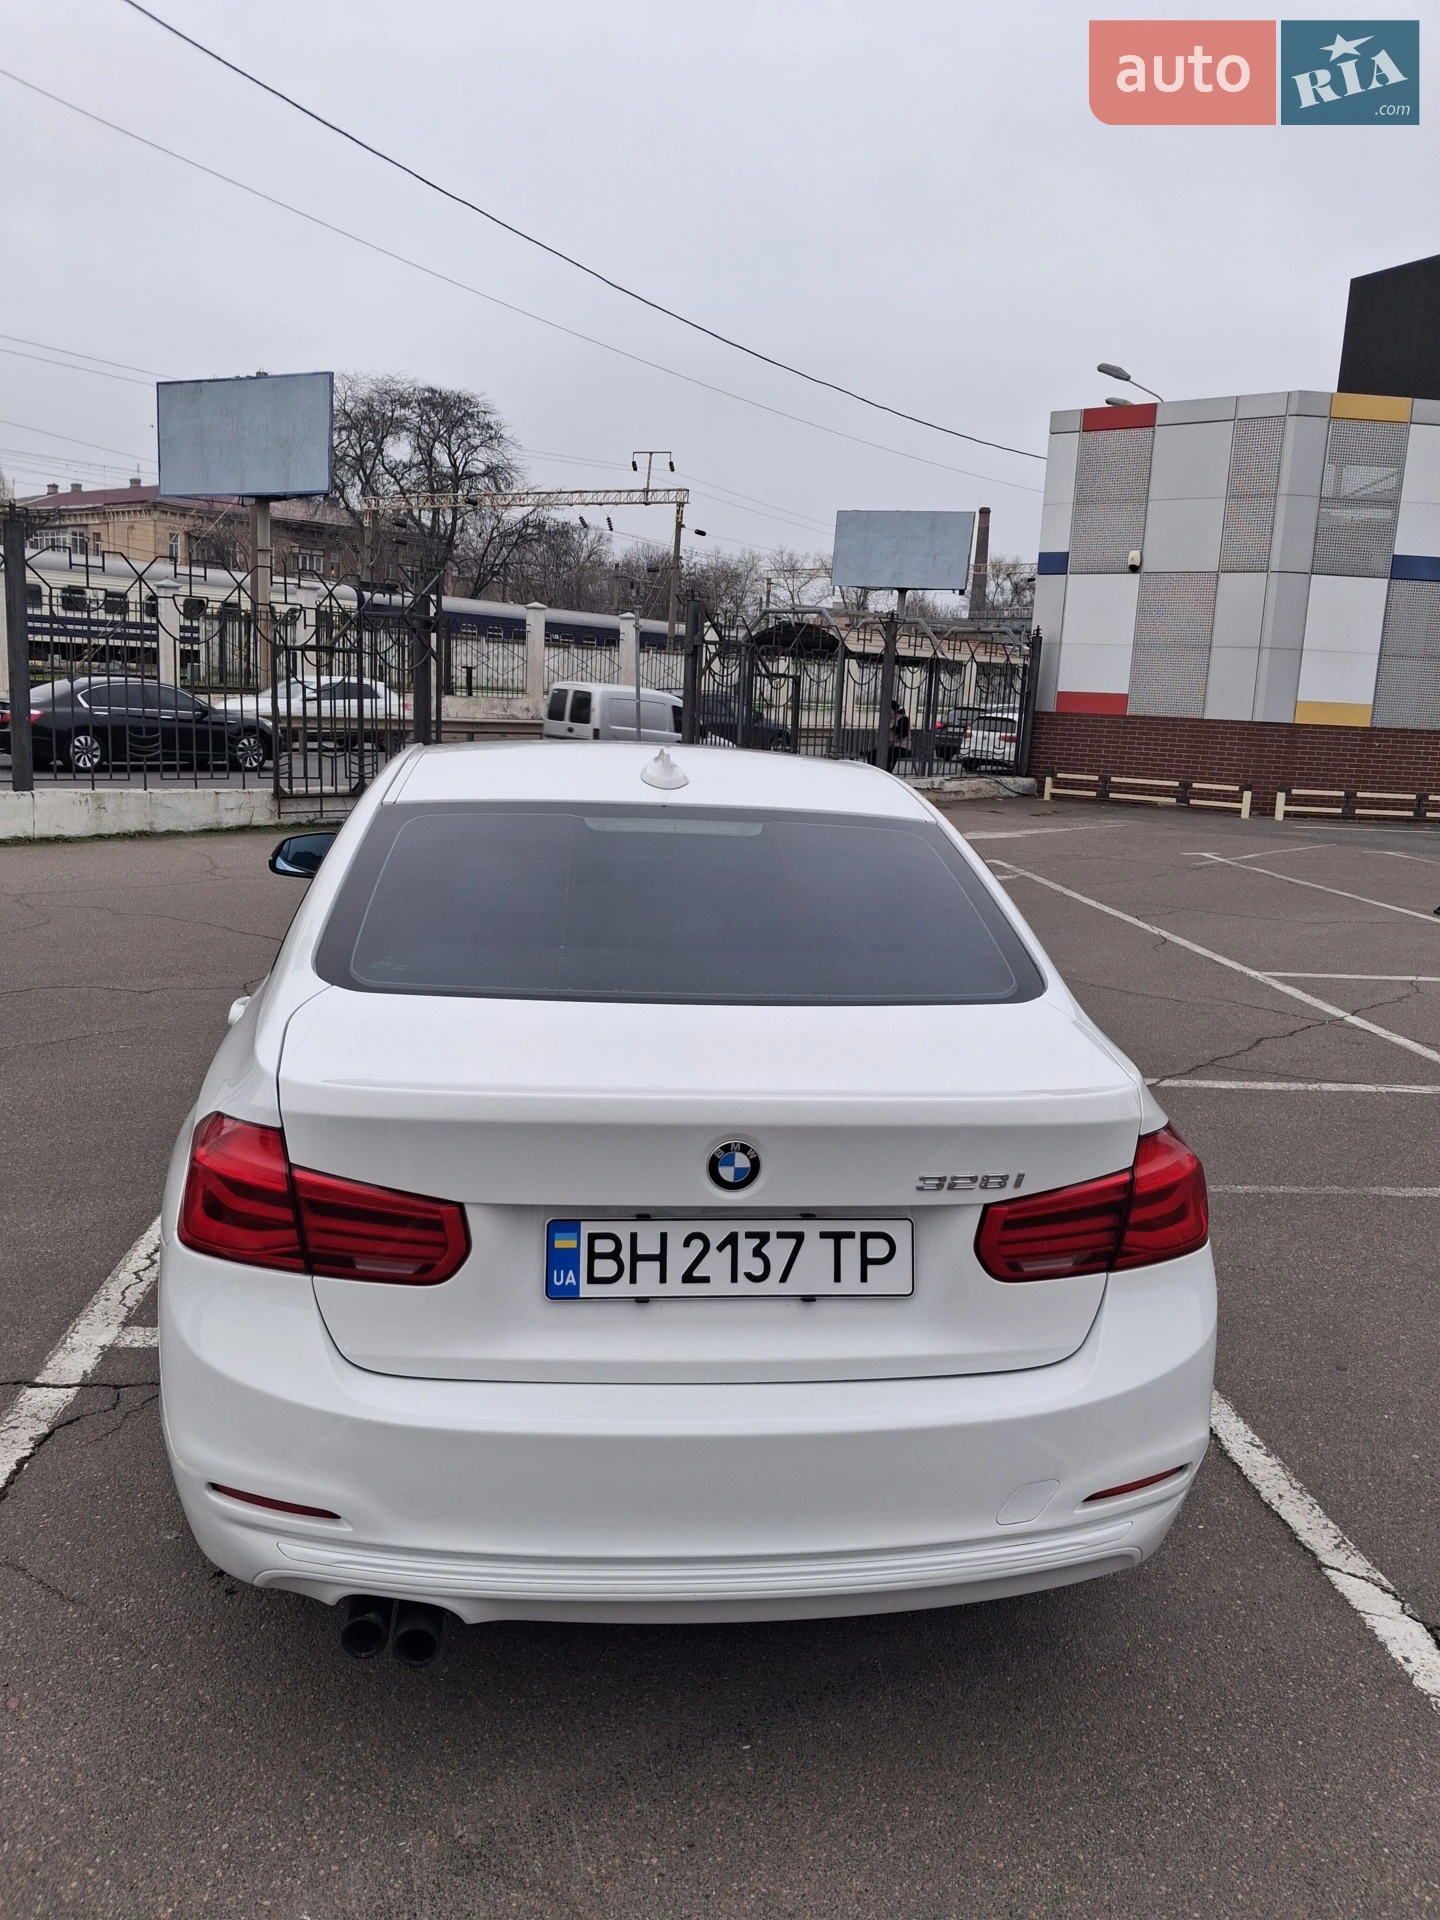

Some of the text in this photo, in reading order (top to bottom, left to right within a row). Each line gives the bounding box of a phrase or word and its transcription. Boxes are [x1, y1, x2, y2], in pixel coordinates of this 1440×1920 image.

[713, 1142, 757, 1159] BMW
[915, 1173, 1026, 1190] 328i
[586, 1230, 897, 1285] BH 2137 TP
[553, 1269, 577, 1286] UA
